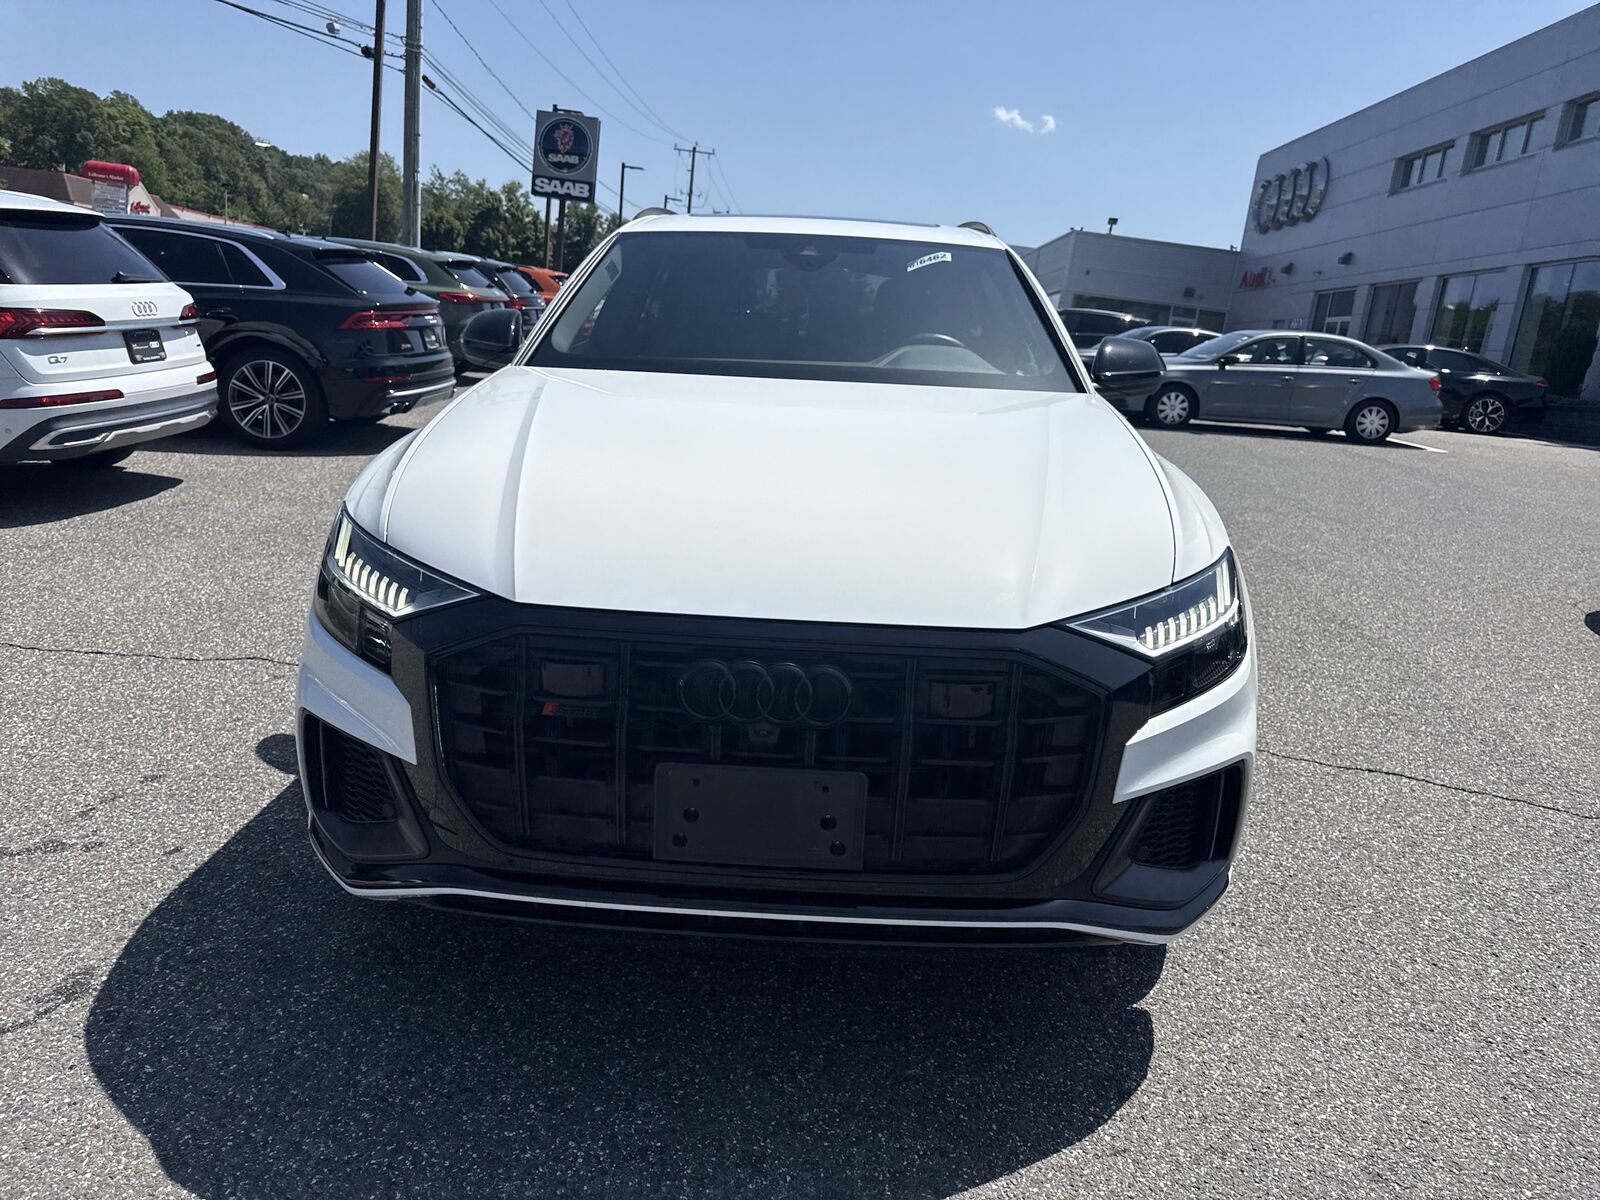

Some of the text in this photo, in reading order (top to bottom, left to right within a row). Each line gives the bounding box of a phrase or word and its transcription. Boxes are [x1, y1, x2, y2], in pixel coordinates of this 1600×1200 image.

[548, 153, 579, 164] SAAB
[533, 177, 590, 198] SAAB
[48, 355, 68, 365] Q7
